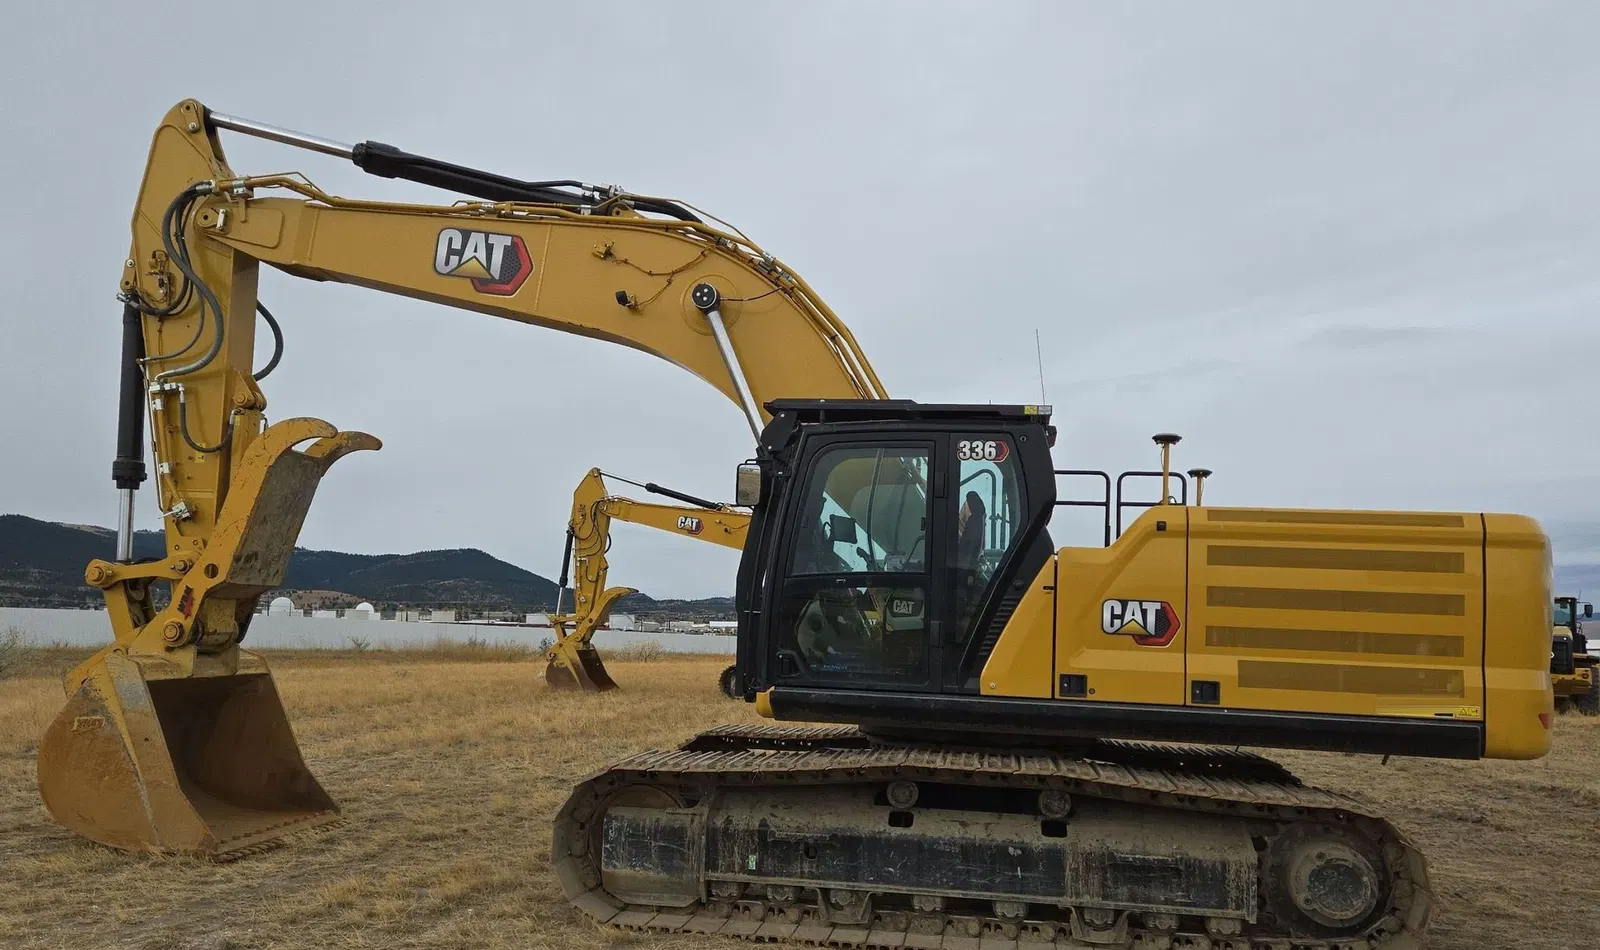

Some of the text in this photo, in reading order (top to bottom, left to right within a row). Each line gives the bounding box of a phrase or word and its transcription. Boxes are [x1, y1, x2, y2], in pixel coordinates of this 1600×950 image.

[435, 228, 512, 280] CAT
[959, 440, 997, 460] 336
[677, 516, 699, 531] CAT
[893, 600, 915, 615] CAT
[1103, 599, 1161, 635] CAT
